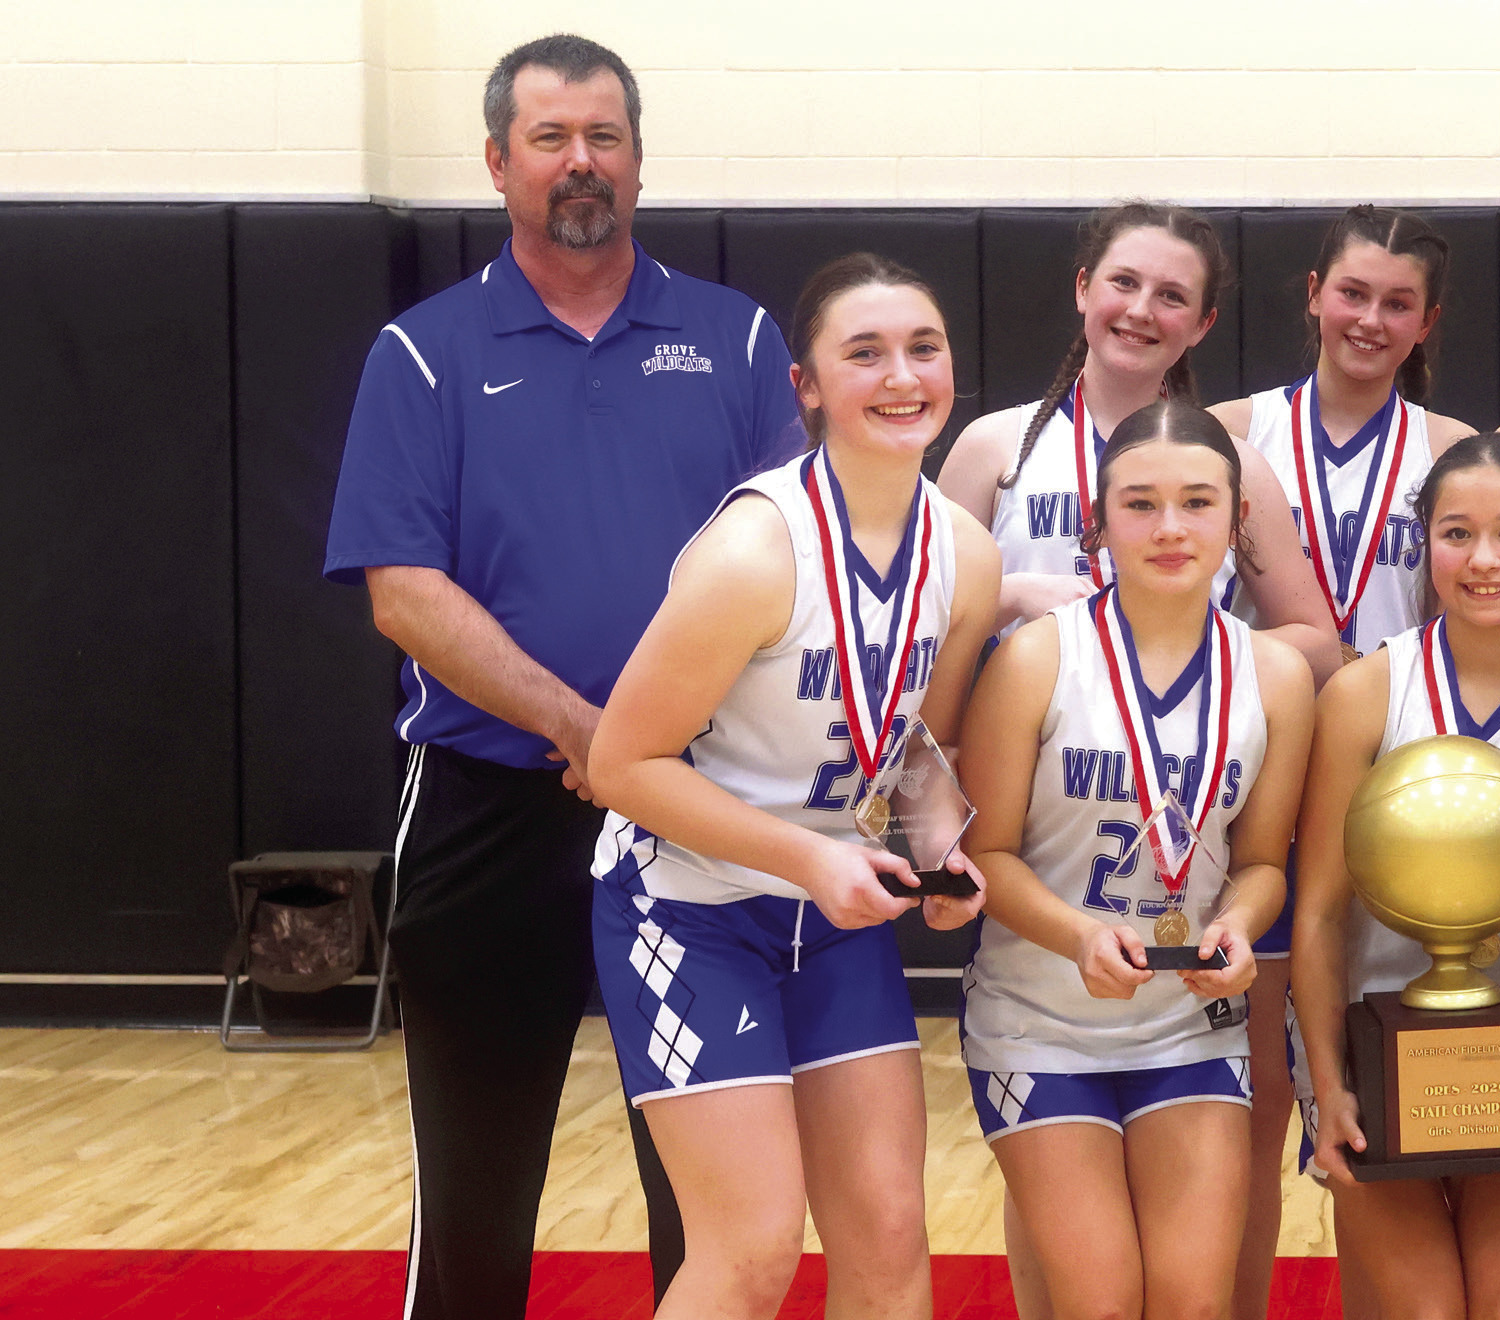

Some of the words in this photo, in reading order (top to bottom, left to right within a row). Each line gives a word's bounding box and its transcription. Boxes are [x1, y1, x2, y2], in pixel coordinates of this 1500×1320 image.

[655, 344, 697, 356] GROVE
[641, 355, 713, 376] WILDCATS
[1407, 1047, 1459, 1057] AMERICAN
[1410, 1105, 1449, 1119] STATE
[1428, 1126, 1453, 1137] Girls
[1459, 1123, 1499, 1135] Division
